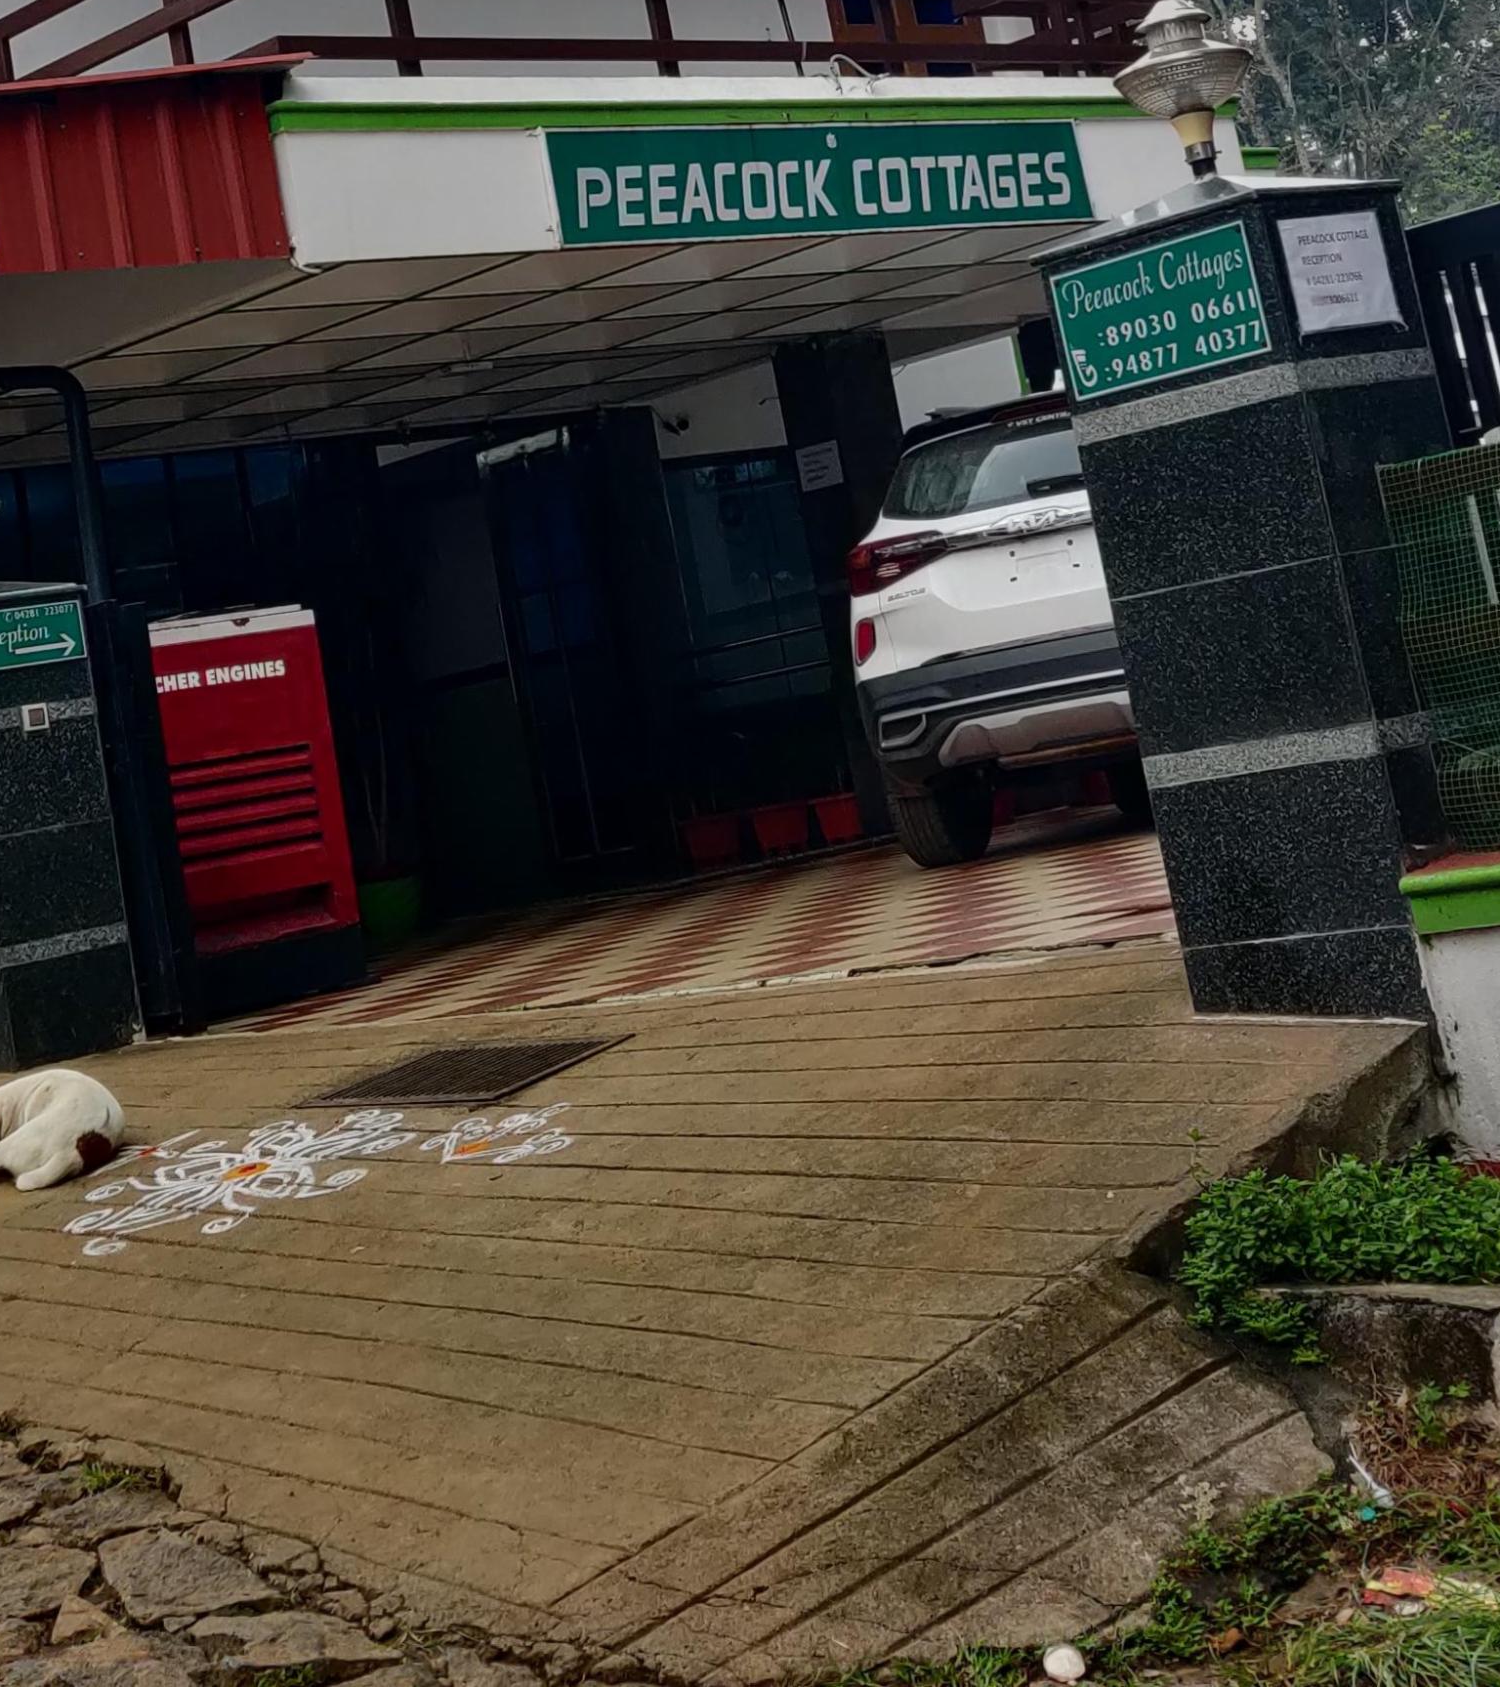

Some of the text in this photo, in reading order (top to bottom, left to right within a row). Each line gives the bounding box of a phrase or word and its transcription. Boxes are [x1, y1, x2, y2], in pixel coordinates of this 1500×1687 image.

[576, 151, 1072, 229] PEEACOCK COTTAGES
[1061, 248, 1243, 319] Peeacock Cottages
[1191, 287, 1257, 324] 06611
[1195, 320, 1261, 356] 40377
[205, 659, 286, 686] ENGINES
